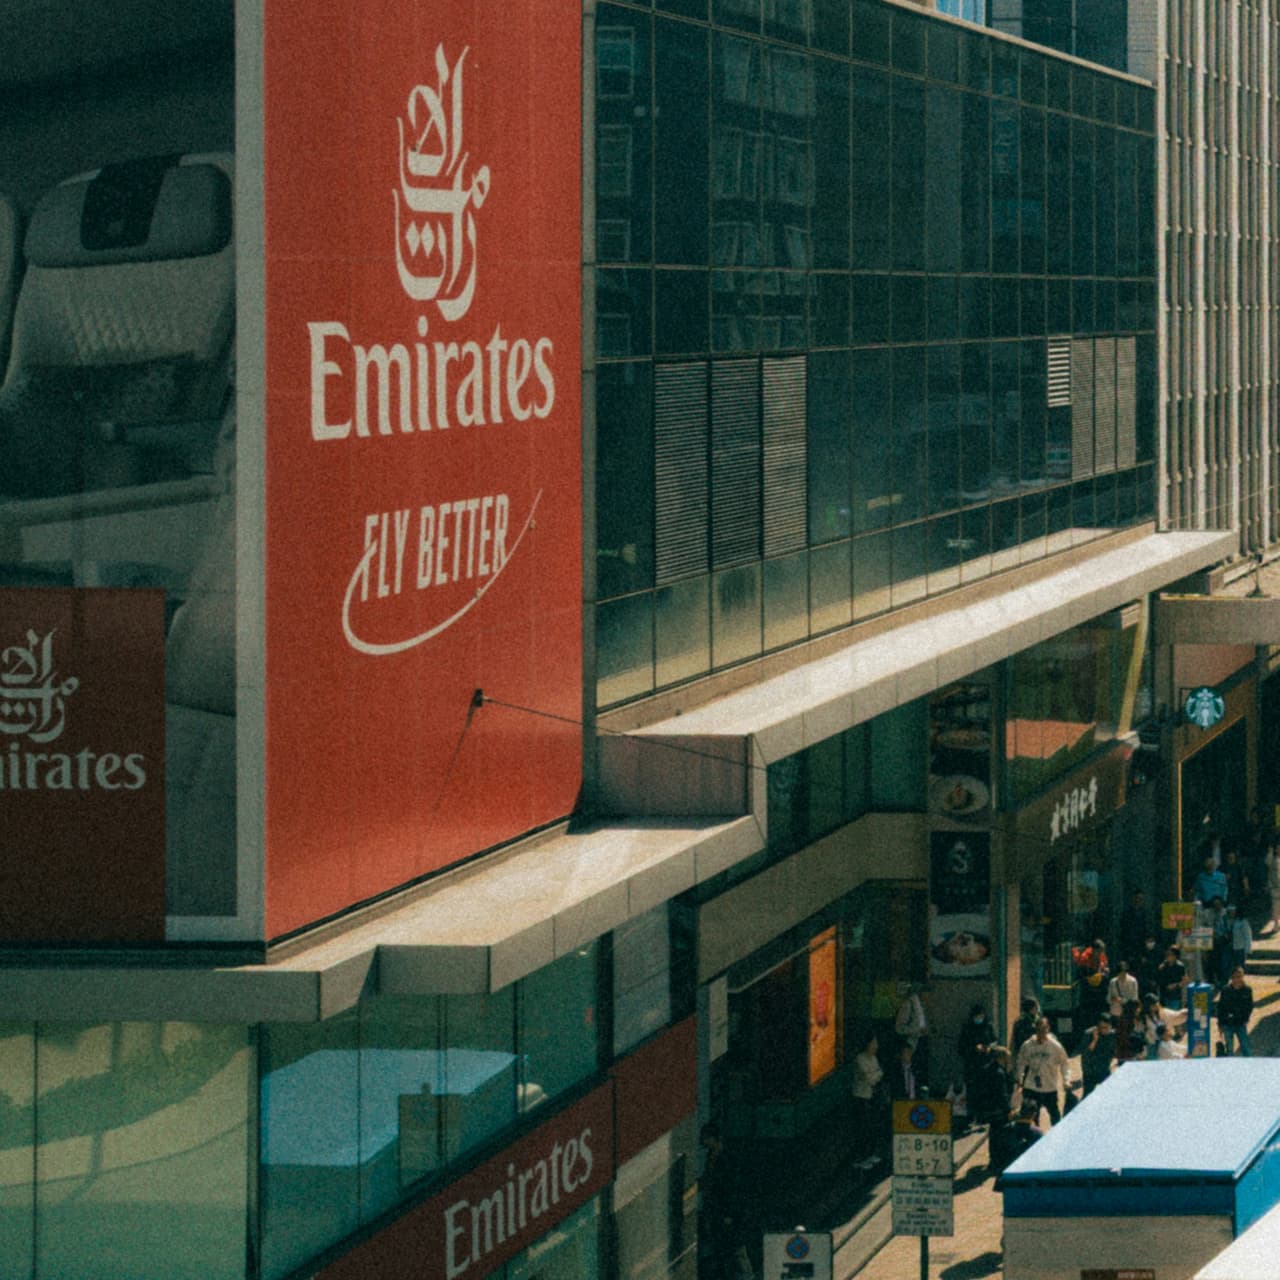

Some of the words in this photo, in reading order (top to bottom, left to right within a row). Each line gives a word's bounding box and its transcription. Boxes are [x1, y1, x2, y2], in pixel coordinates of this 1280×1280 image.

[307, 315, 555, 441] Emirates
[361, 509, 411, 602] FLY
[417, 494, 509, 590] BETTER
[0, 741, 147, 790] irates
[444, 1128, 593, 1280] Emirates
